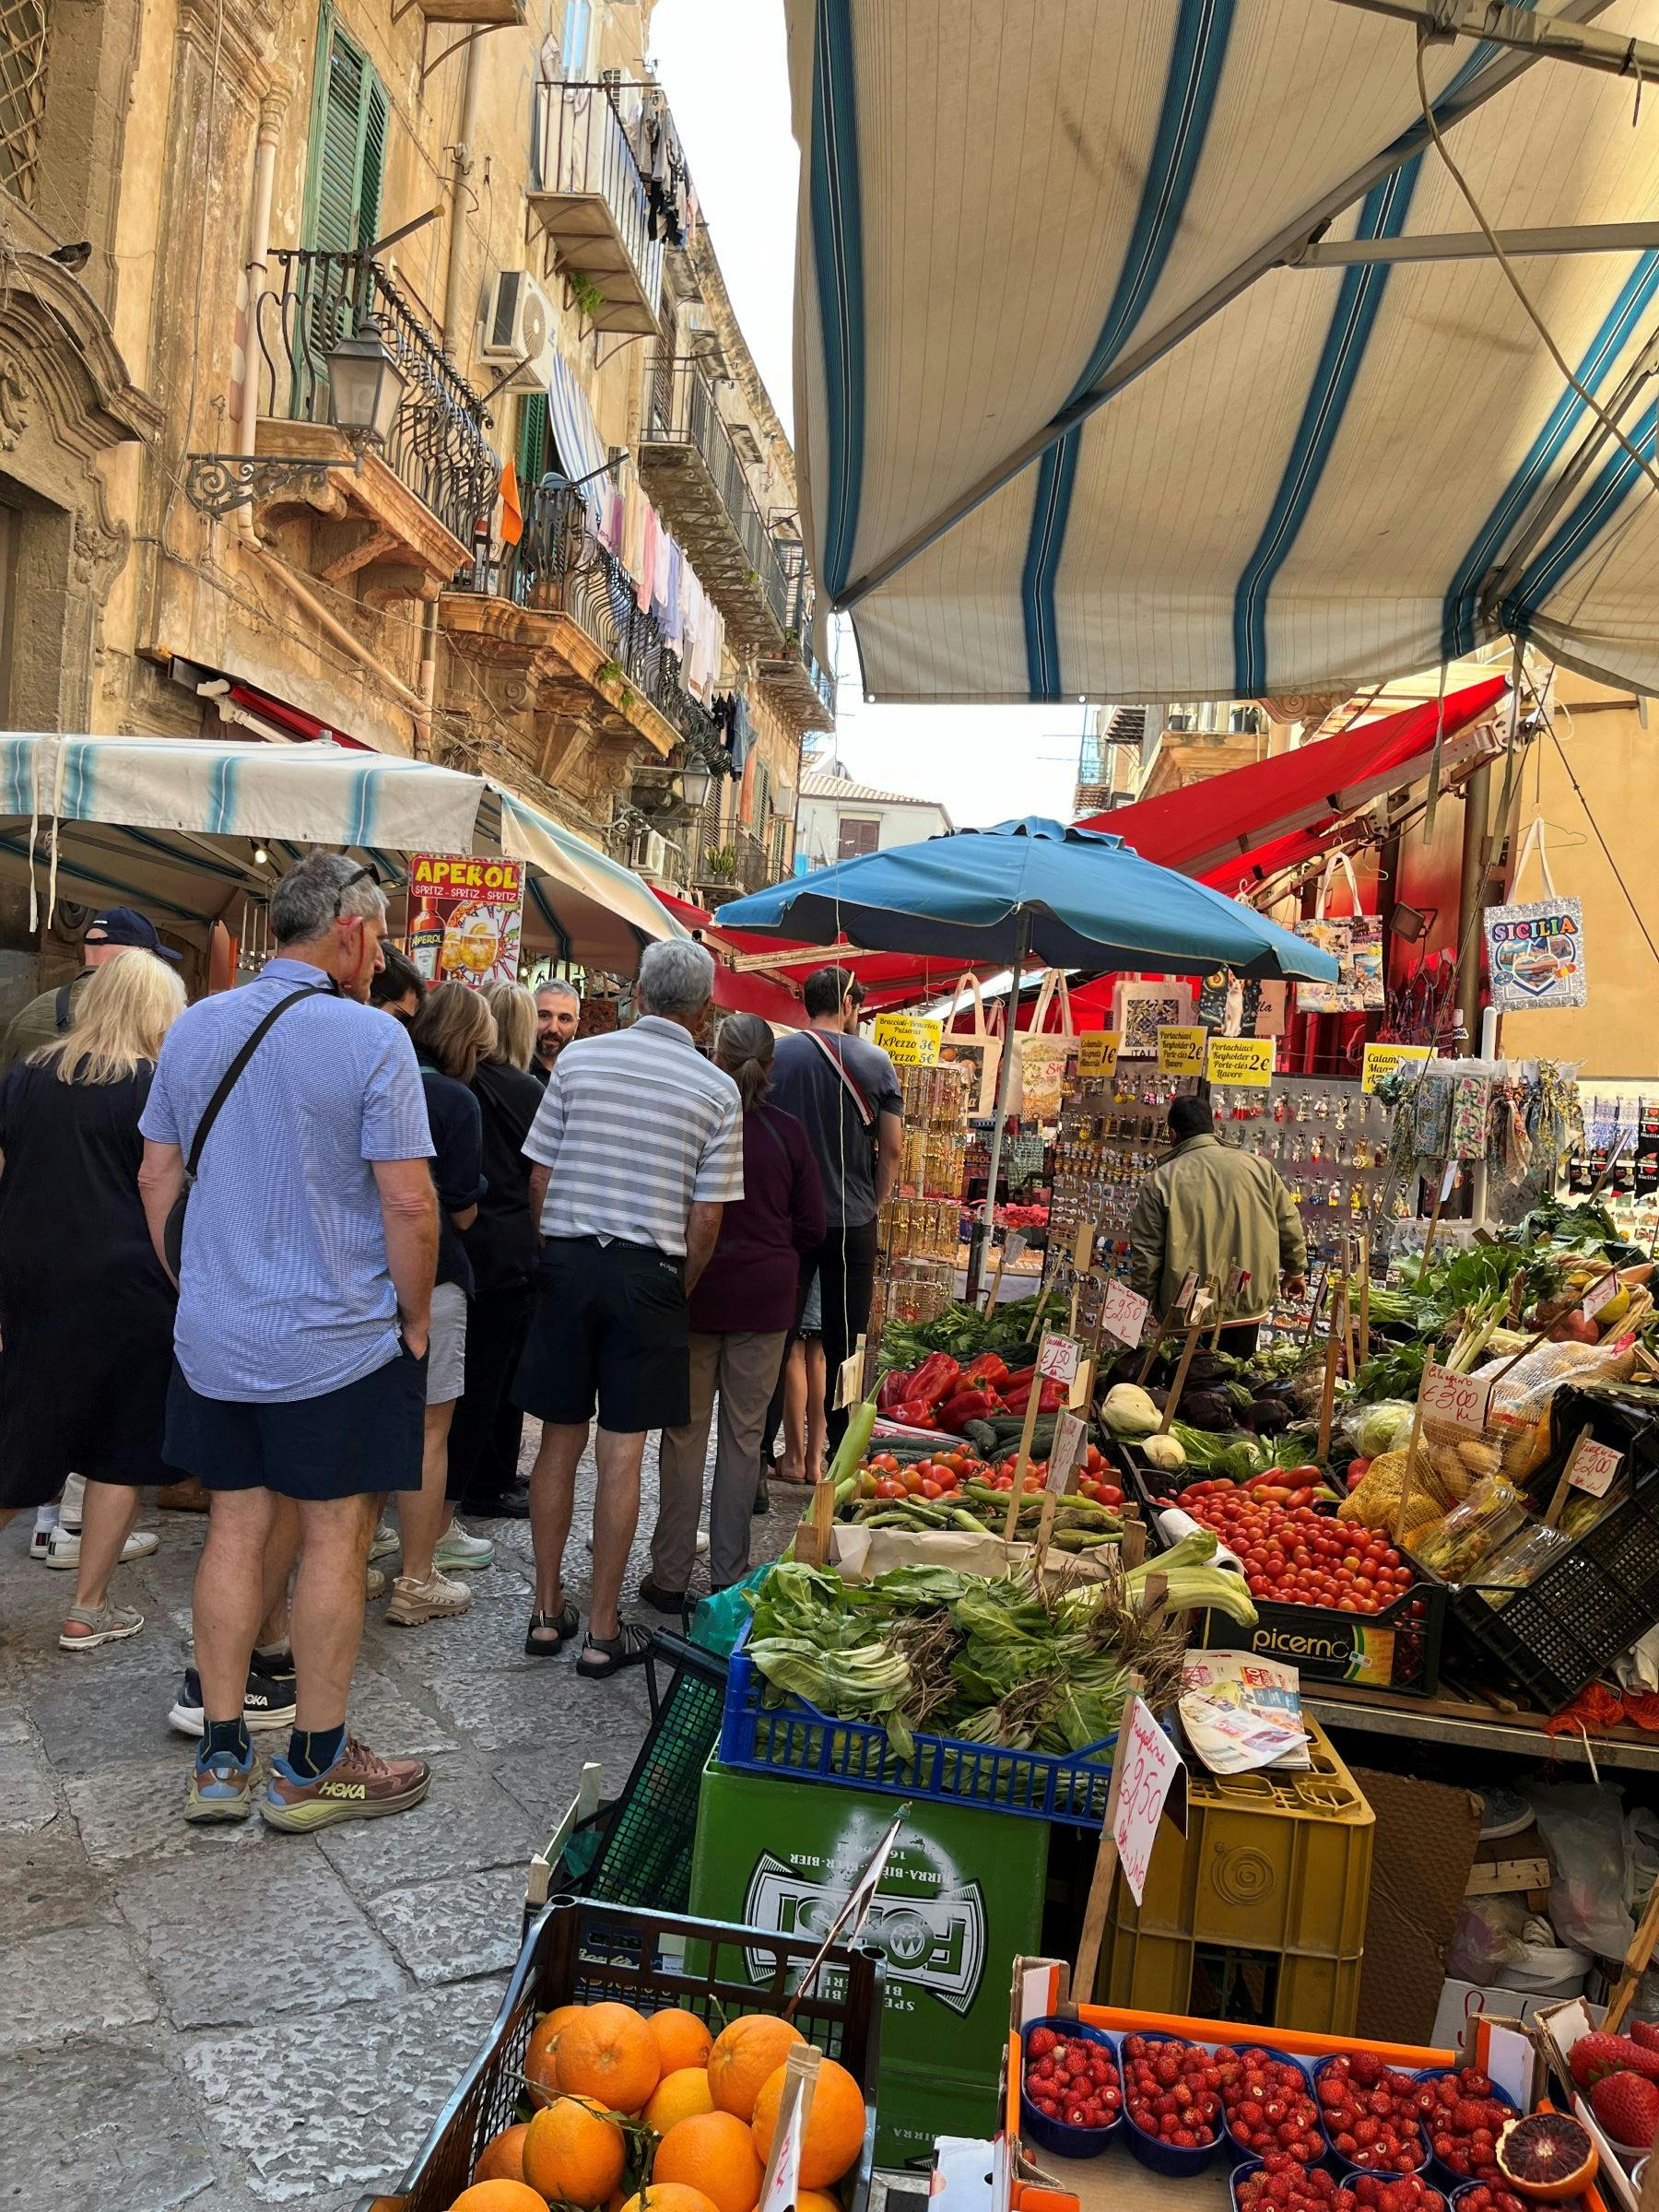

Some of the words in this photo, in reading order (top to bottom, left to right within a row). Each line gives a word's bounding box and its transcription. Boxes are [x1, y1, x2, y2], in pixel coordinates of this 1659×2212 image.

[416, 861, 517, 889] APEROL
[415, 886, 443, 896] SPRITZ
[451, 888, 479, 899] SPRITZ
[487, 890, 516, 901] SPRITZ
[1494, 916, 1577, 941] SICILIA
[411, 934, 442, 948] APEROL
[1101, 1044, 1116, 1064] 1€
[1187, 1042, 1203, 1060] 2€
[1210, 1042, 1253, 1052] Portachiavi
[1213, 1052, 1250, 1061] Keyholder
[1248, 1054, 1270, 1071] 2€
[1217, 1069, 1242, 1079] Llavero
[1252, 1628, 1350, 1660] picerno
[244, 1693, 269, 1707] OKA
[318, 1781, 367, 1800] HOKA
